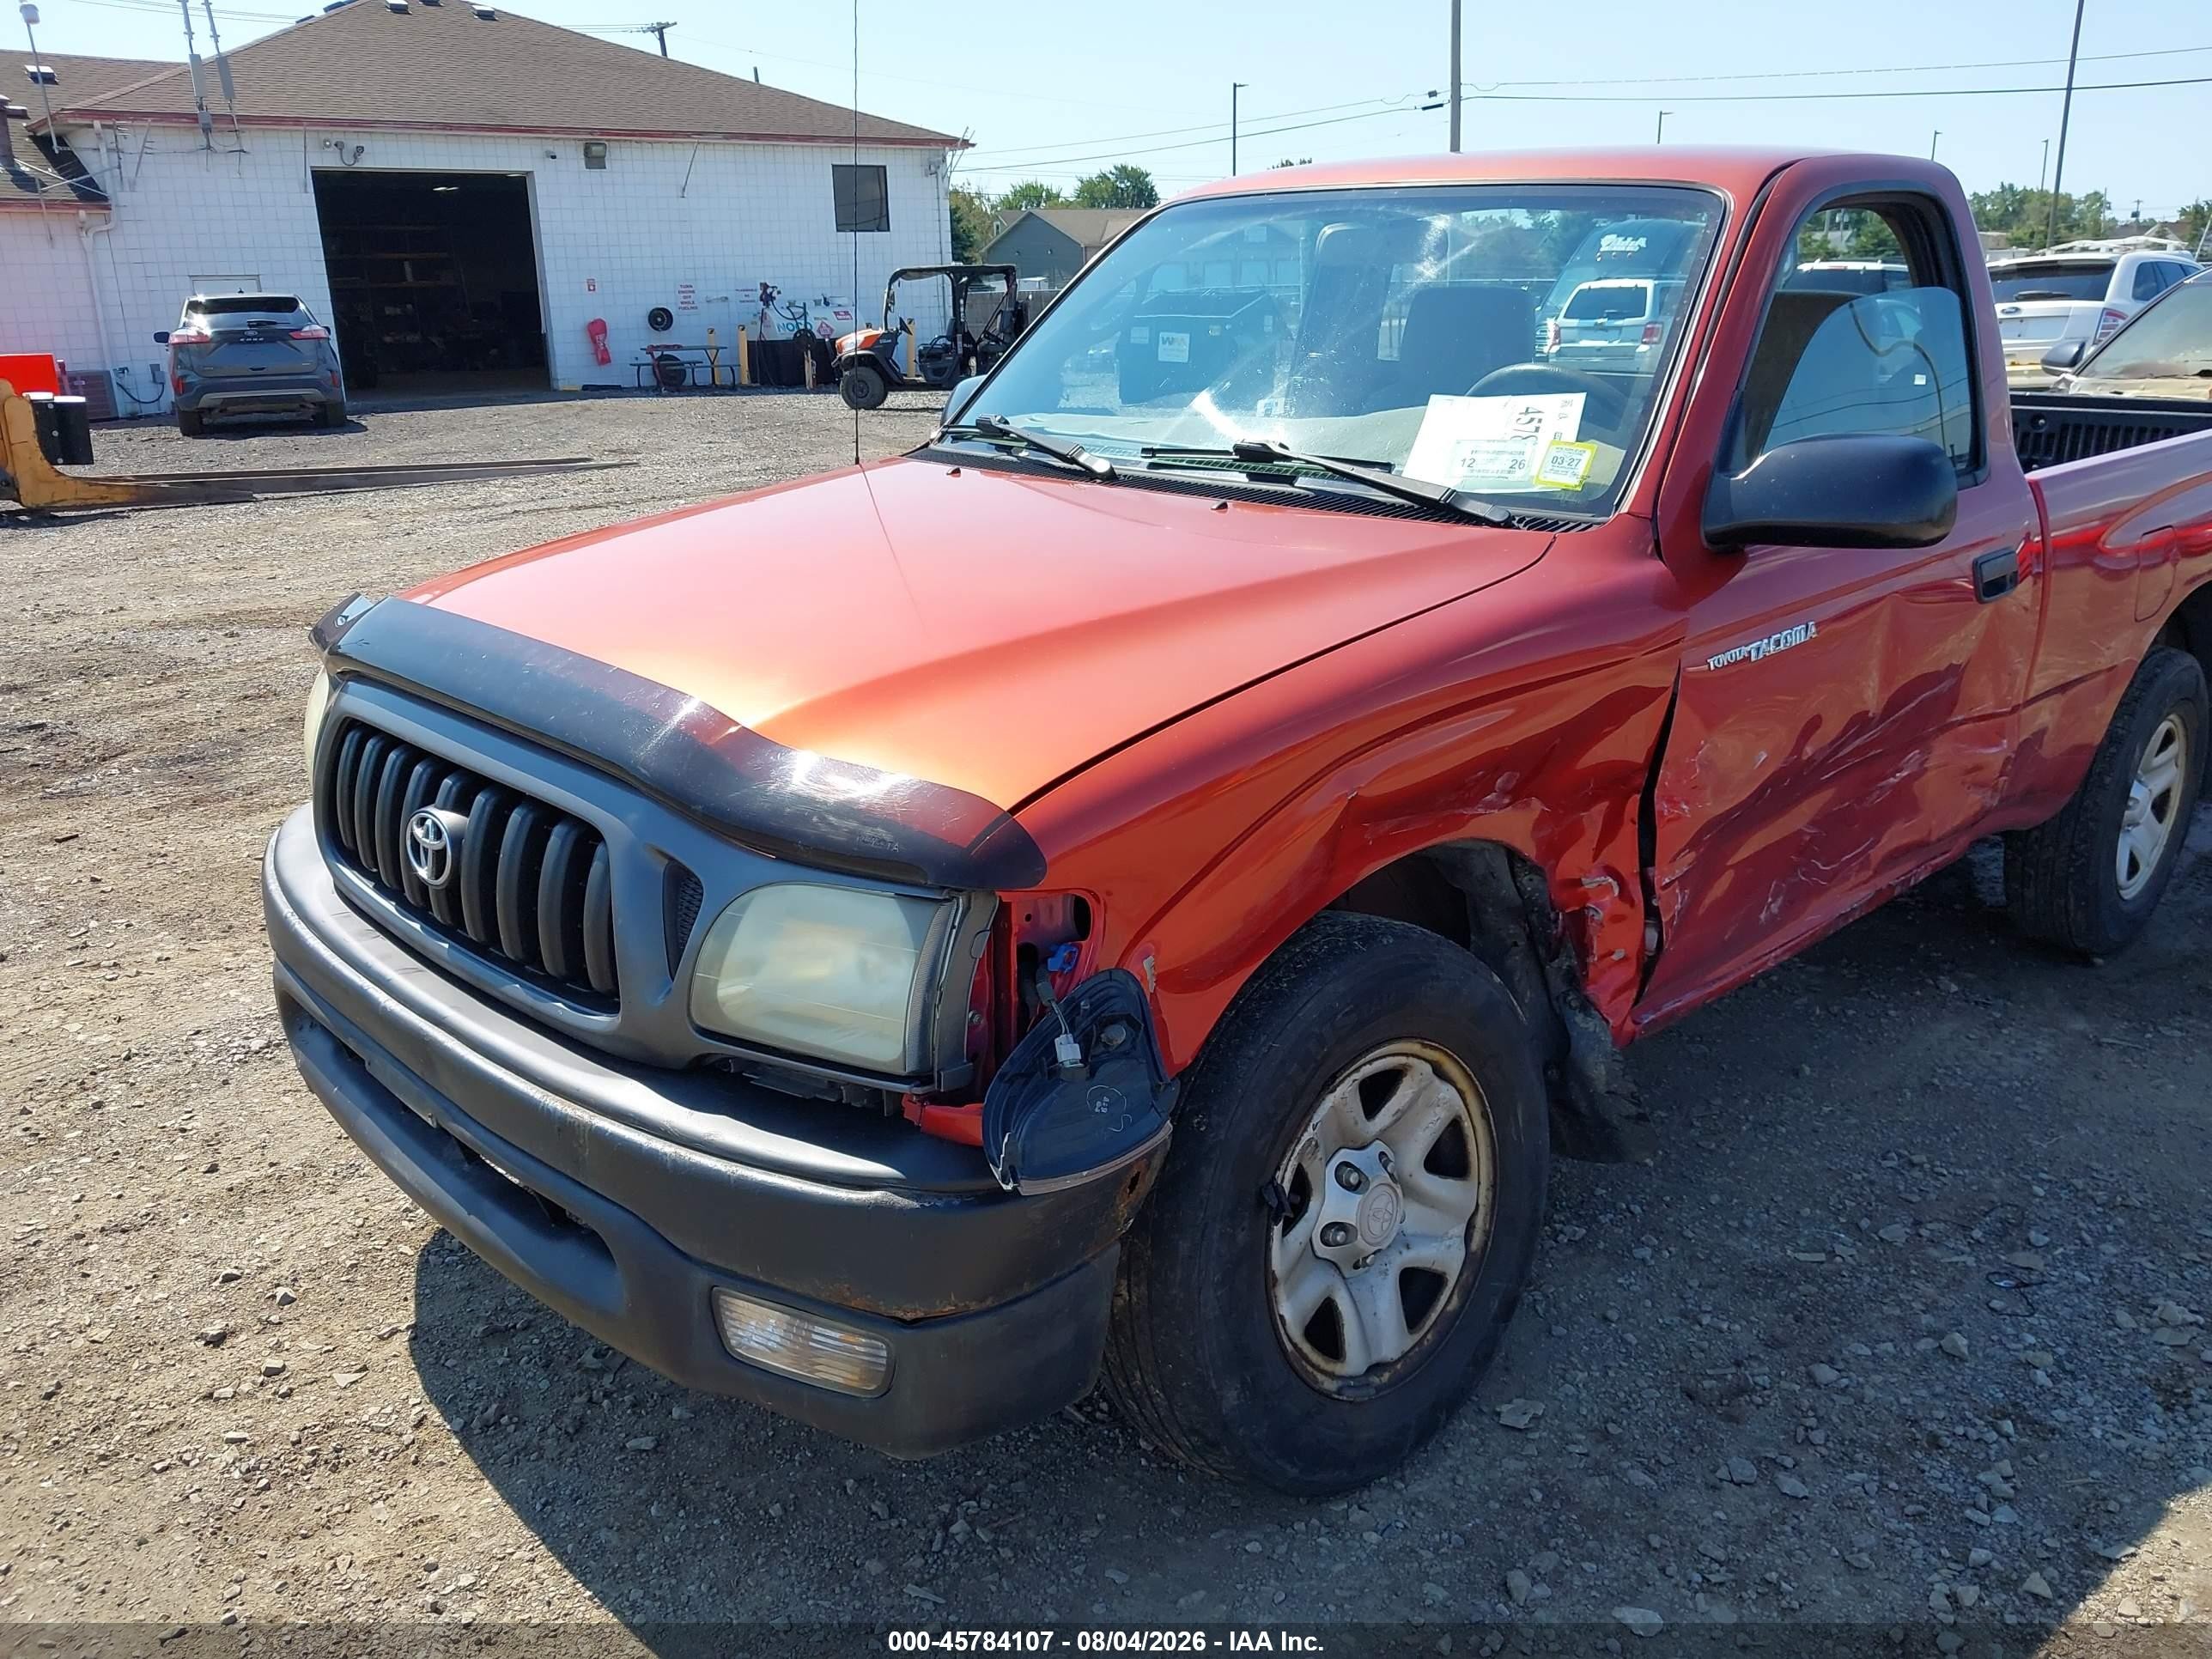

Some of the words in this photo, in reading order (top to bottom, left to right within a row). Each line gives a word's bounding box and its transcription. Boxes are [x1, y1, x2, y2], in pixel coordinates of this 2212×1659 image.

[1461, 457, 1476, 468] 12
[1509, 459, 1526, 470] 26
[1707, 646, 1748, 672] TOYOTA
[1748, 621, 1819, 662] TACOMA
